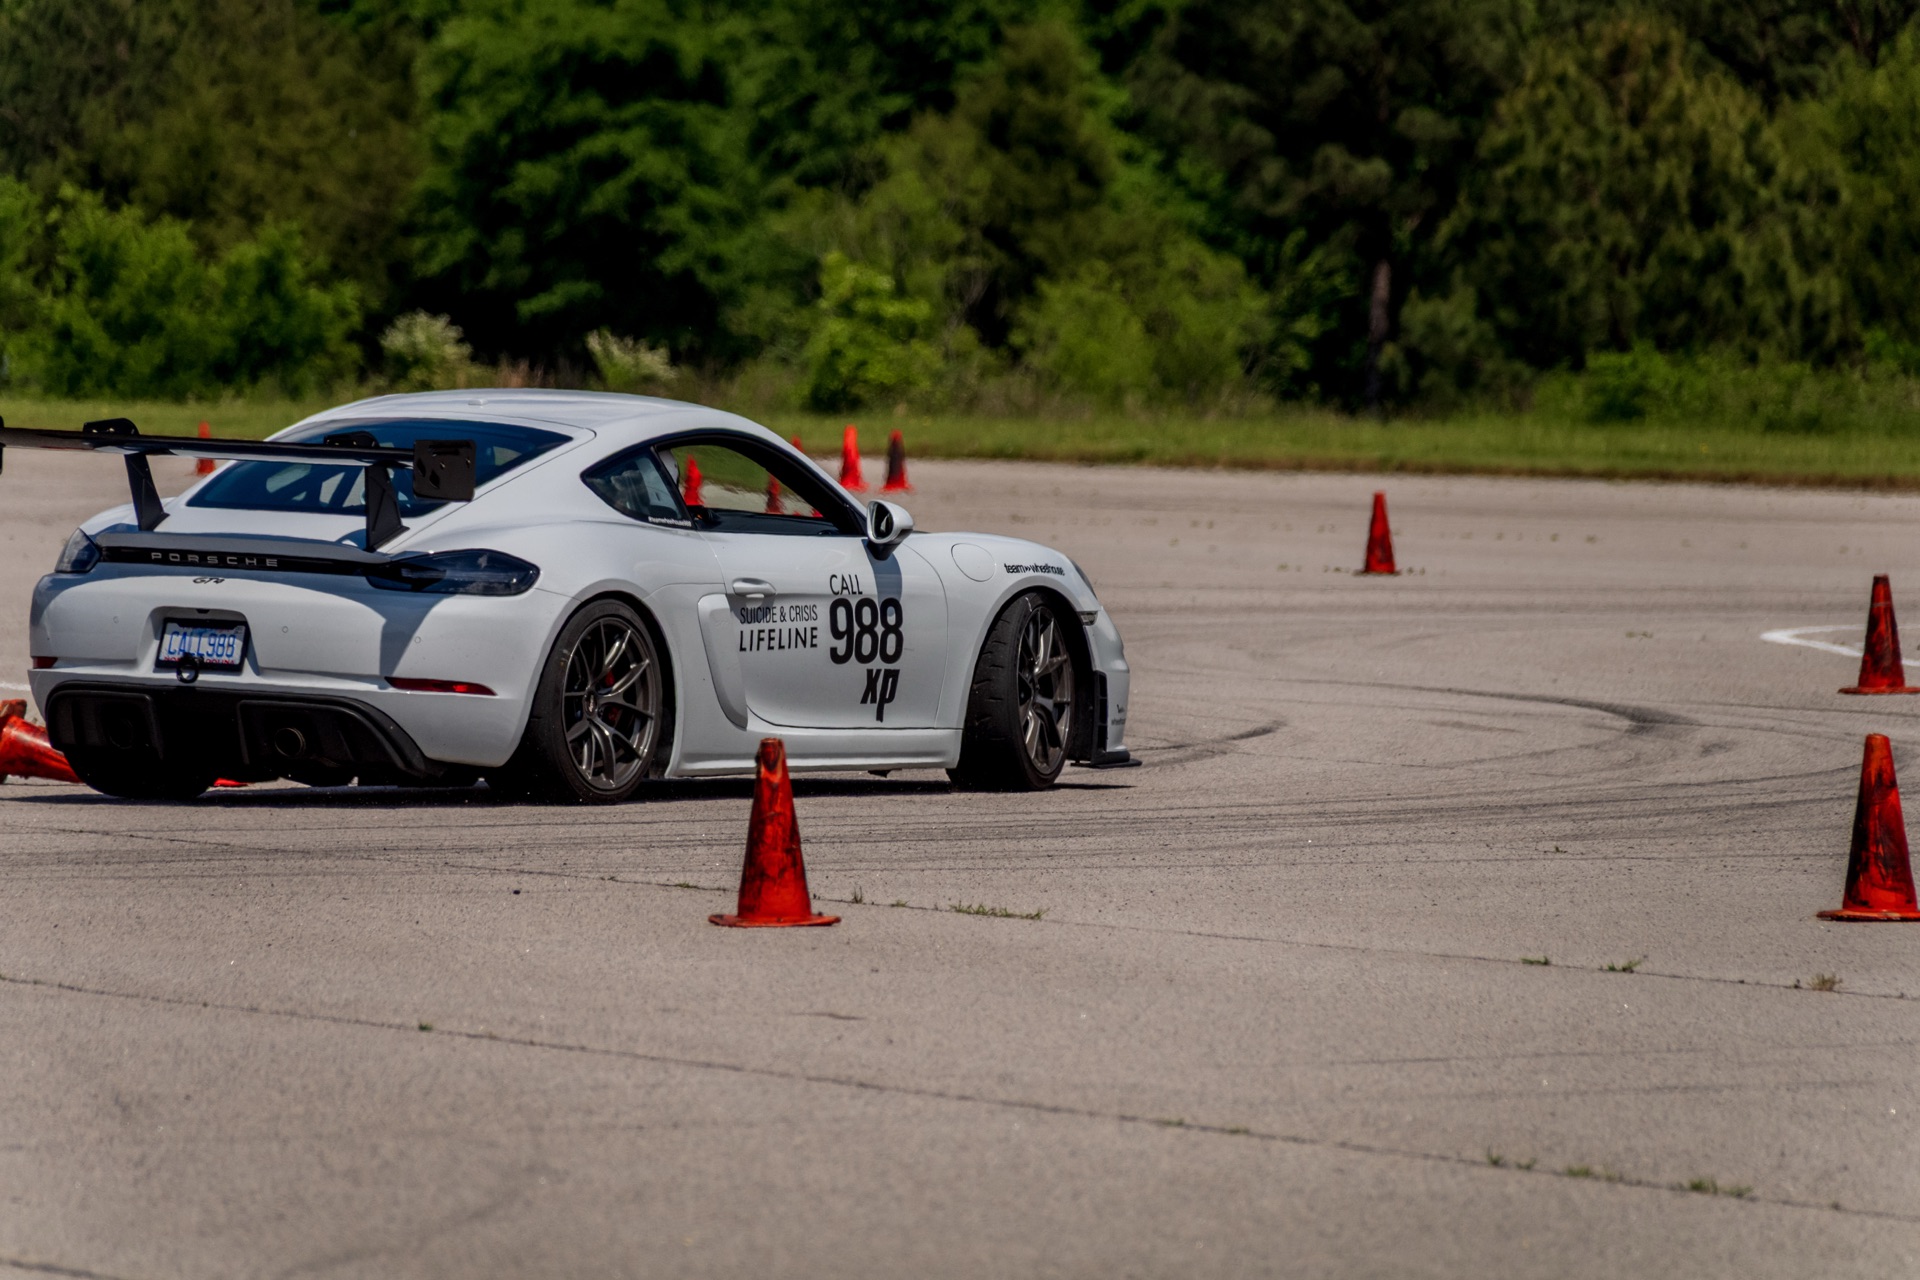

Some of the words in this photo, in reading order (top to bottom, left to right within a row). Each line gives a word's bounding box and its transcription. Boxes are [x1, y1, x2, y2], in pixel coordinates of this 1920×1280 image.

[151, 552, 278, 567] PORSCHE
[829, 574, 863, 596] CALL
[740, 606, 777, 624] SUICIDE
[779, 610, 787, 623] &
[788, 604, 818, 623] CRISIS
[739, 627, 818, 652] LIFELINE
[829, 597, 904, 665] 988
[168, 632, 236, 658] CALL988
[860, 668, 900, 723] xp
